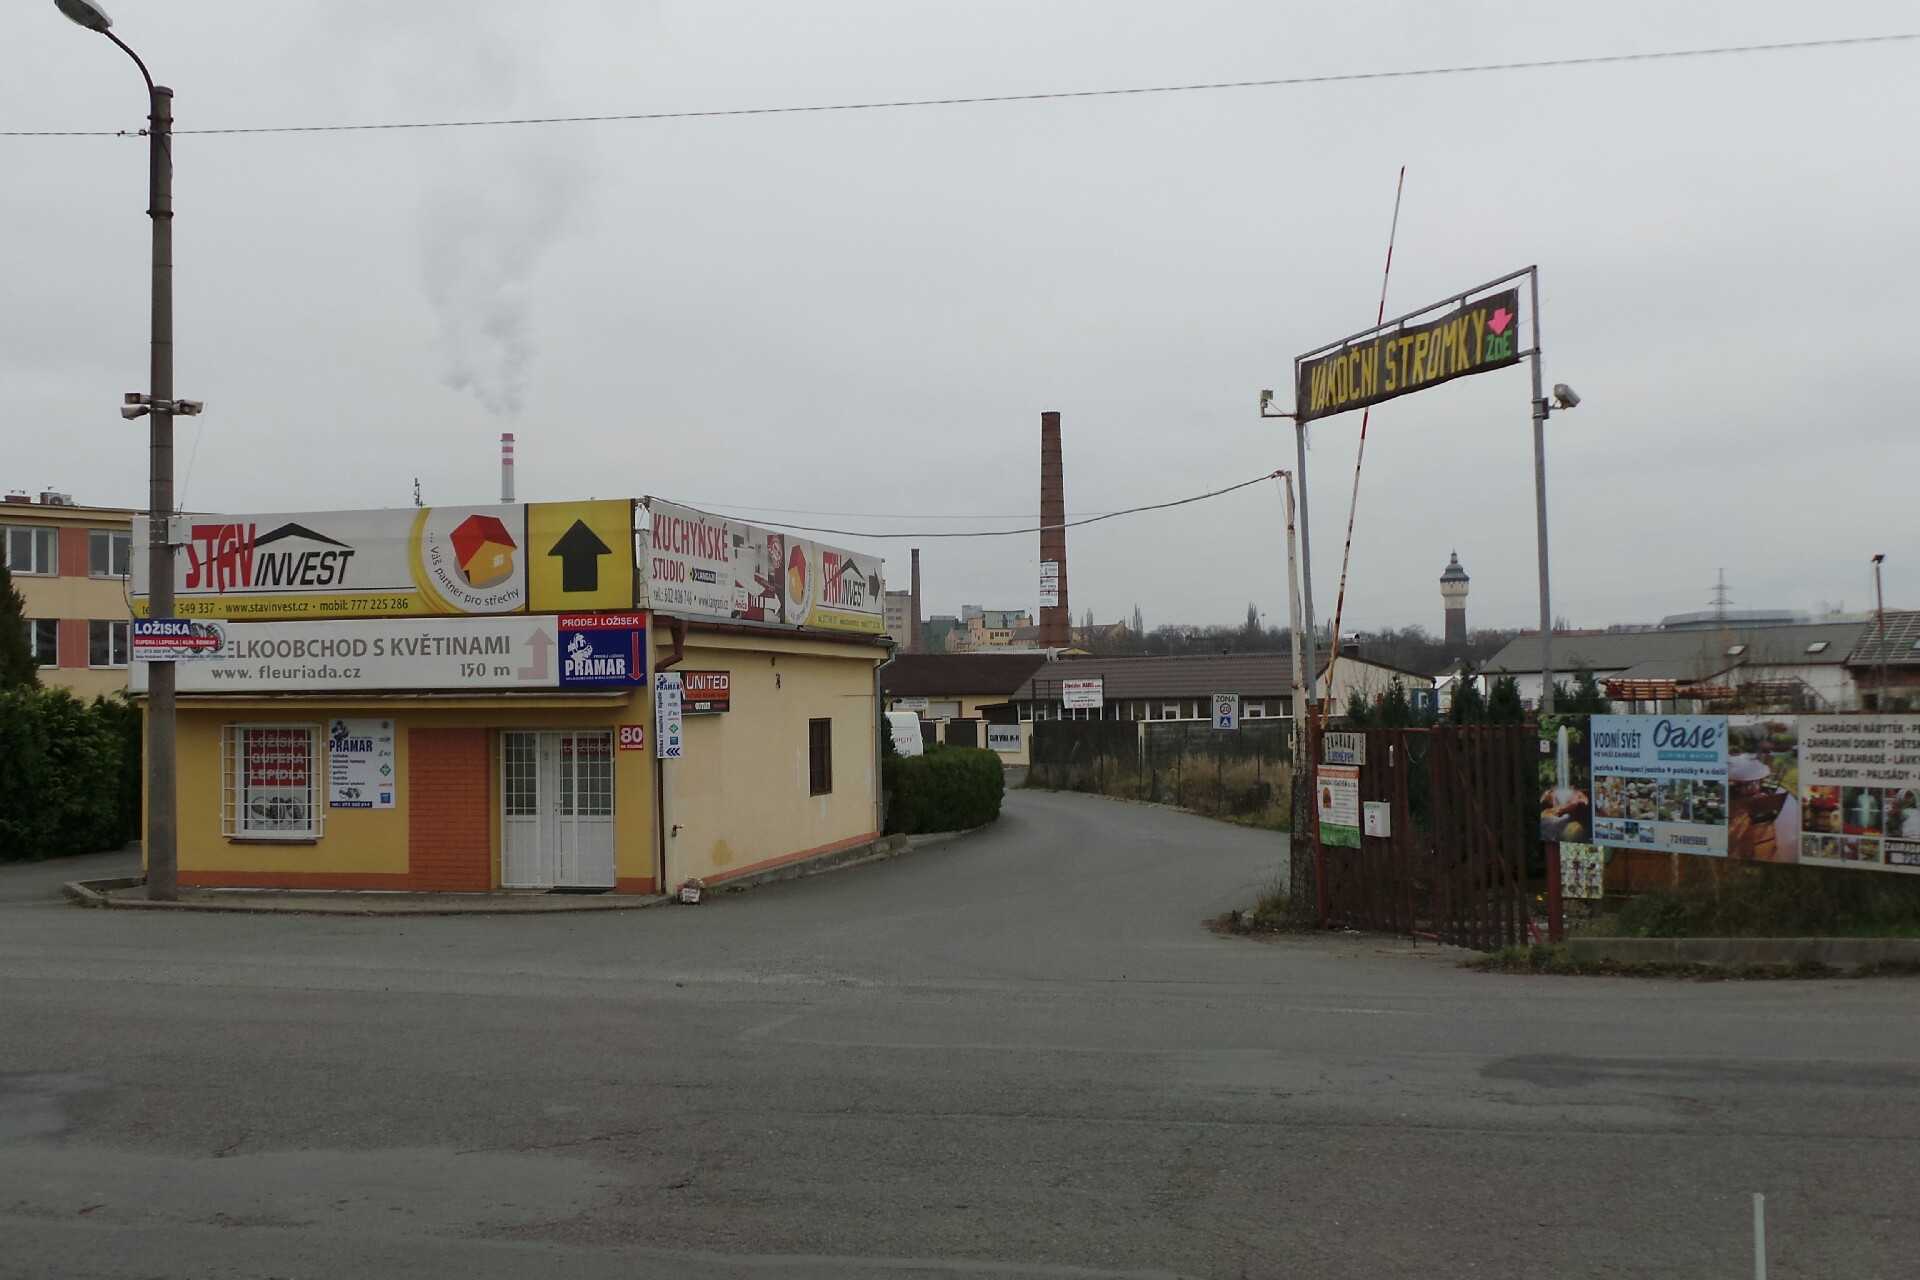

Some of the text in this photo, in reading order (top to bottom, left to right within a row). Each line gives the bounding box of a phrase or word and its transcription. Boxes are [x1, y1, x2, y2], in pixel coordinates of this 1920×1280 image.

[1385, 308, 1487, 392] STROMKY
[1486, 331, 1512, 362] ZDE
[652, 513, 729, 563] KUCHYŇSKÉ
[430, 546, 519, 606] Váš partner pro střechy
[652, 557, 685, 584] STUDIO
[179, 603, 196, 614] 549
[198, 602, 215, 614] 337
[225, 602, 309, 613] www.stavinvest.cz
[320, 600, 348, 612] mobil:
[351, 600, 369, 611] 777
[371, 599, 388, 610] 225
[391, 598, 408, 609] 286
[134, 620, 190, 635] LOŽISKA
[562, 616, 639, 627] PRODEJ LOŽISEK
[373, 638, 384, 657] S
[391, 634, 510, 656] KVĚTINAMI
[460, 662, 510, 678] 150 m
[565, 658, 625, 676] PRAMAR
[686, 675, 728, 690] UNITED
[620, 727, 643, 743] 80
[1326, 733, 1355, 750] ZAHRADA
[1593, 729, 1641, 749] VODNÍ SVĚT
[1653, 719, 1716, 749] Oase
[329, 739, 373, 753] PRAMAR
